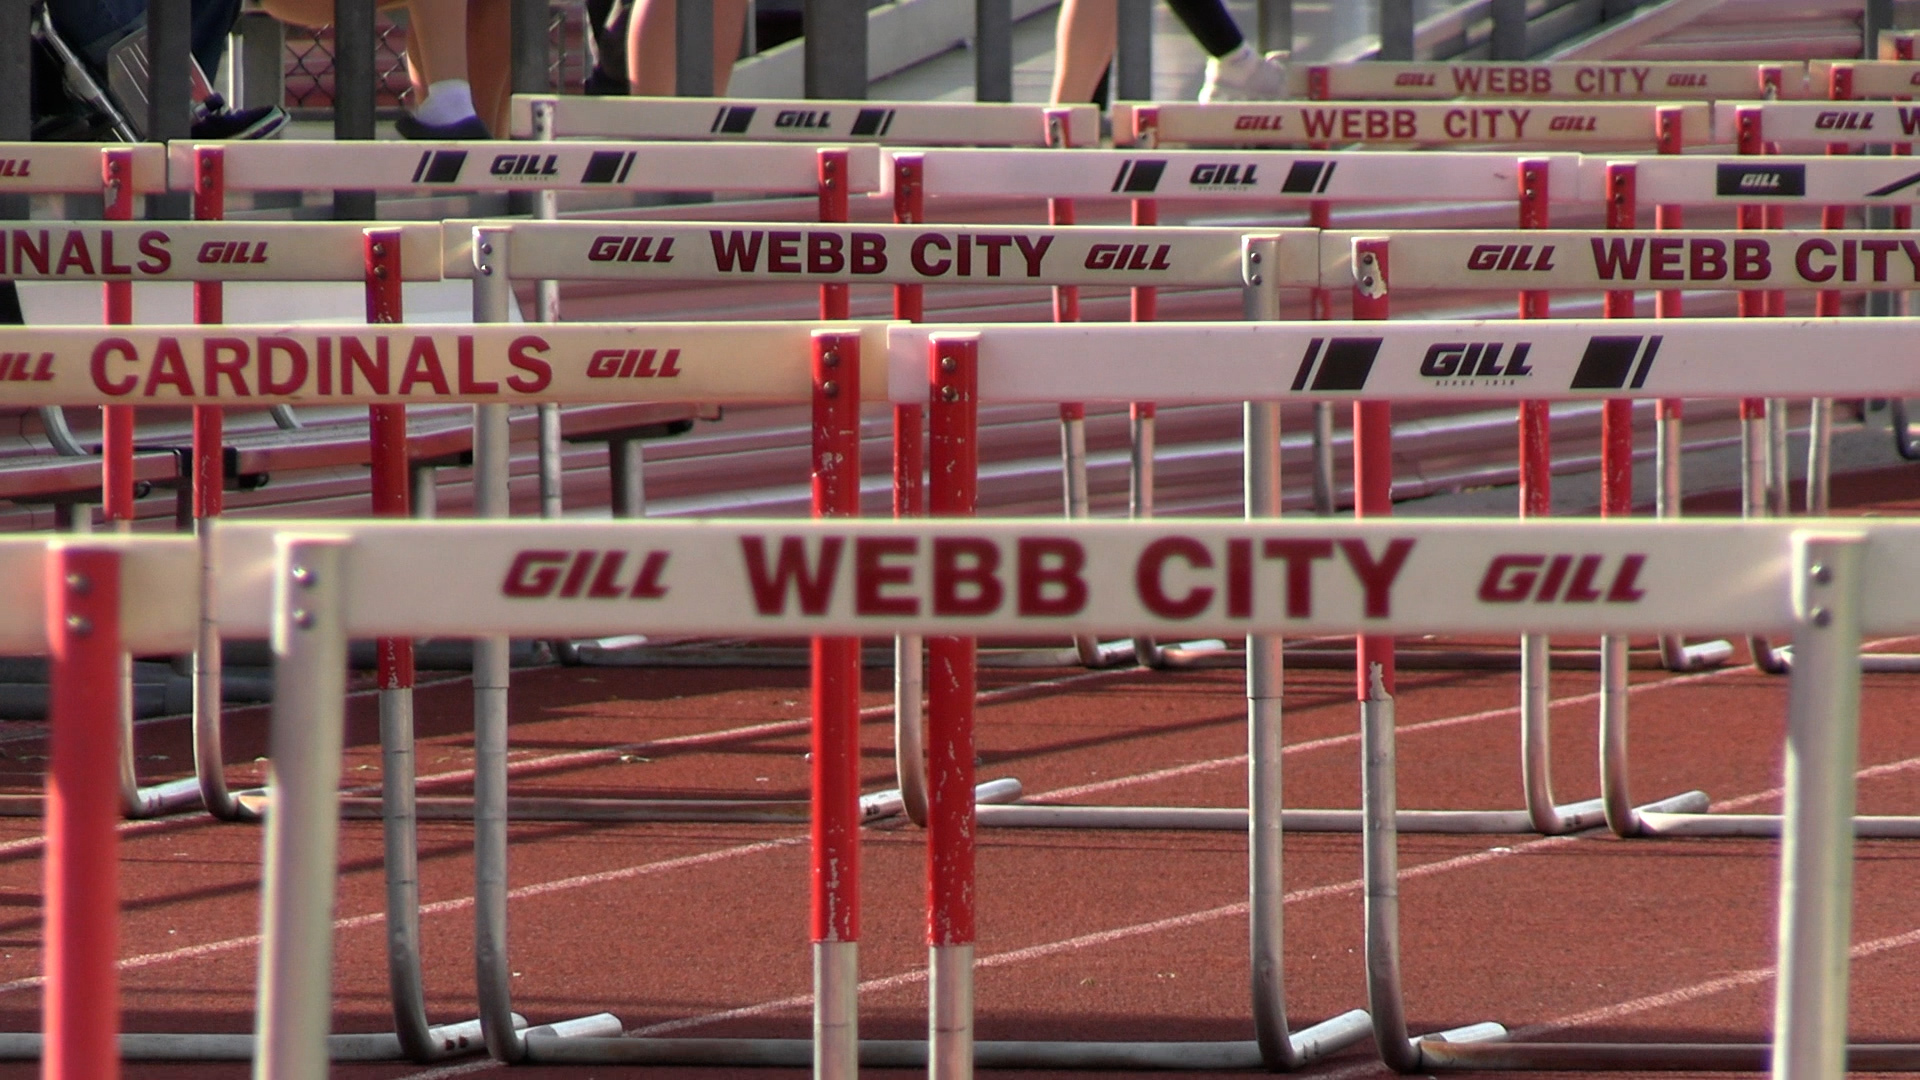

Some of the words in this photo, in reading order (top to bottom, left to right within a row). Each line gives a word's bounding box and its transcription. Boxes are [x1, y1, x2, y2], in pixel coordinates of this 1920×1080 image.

[1395, 72, 1436, 87] GILL
[1452, 67, 1551, 94] WEBB
[1575, 68, 1650, 93] CITY
[1666, 73, 1707, 87] GILL
[775, 110, 830, 128] GILL
[1234, 115, 1282, 131] GILL
[1301, 108, 1416, 139] WEBB
[1444, 108, 1530, 139] CITY
[1548, 116, 1596, 132] GILL
[1815, 111, 1874, 130] GILL
[0, 159, 30, 178] LL
[489, 154, 558, 174] GILL
[1189, 164, 1257, 184] GILL
[1740, 173, 1781, 186] GILL
[196, 241, 268, 264] GILL
[588, 236, 675, 263] GILL
[710, 231, 888, 274] WEBB
[910, 232, 1055, 277] CITY
[1084, 244, 1171, 271] GILL
[1467, 244, 1555, 271] GILL
[1590, 237, 1772, 281] WEBB
[90, 335, 553, 397] CARDINALS
[586, 349, 681, 379] GILL
[1419, 342, 1532, 376] GILL
[502, 550, 670, 599] GILL
[741, 535, 1089, 617] WEBB
[1135, 536, 1415, 620] CITY
[1477, 554, 1645, 603] GILL
